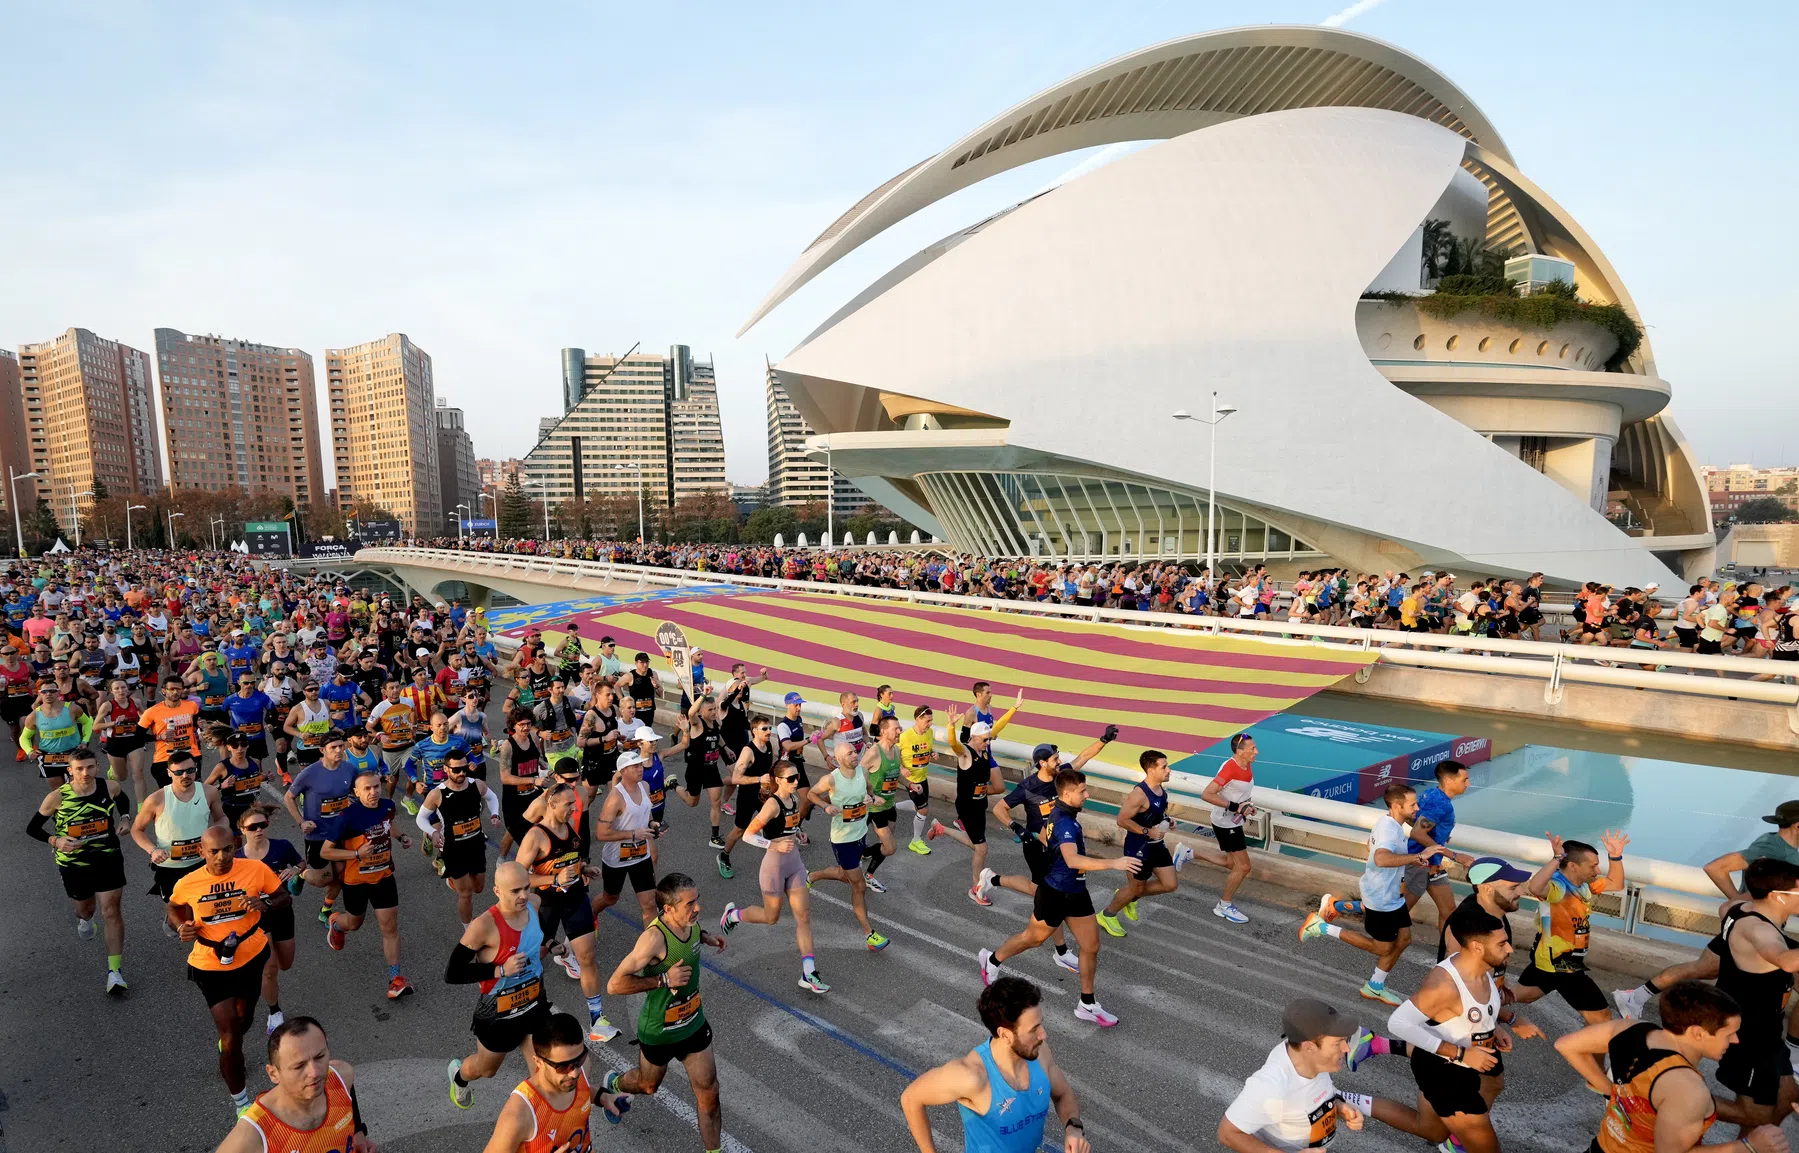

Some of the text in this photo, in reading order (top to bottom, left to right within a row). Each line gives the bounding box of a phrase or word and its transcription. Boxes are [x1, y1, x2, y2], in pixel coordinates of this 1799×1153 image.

[1423, 750, 1450, 766] HYUNDAI
[1324, 782, 1352, 799] ZURICH
[209, 881, 235, 893] JOLLY
[214, 900, 232, 908] 9089
[511, 990, 529, 1002] 11216
